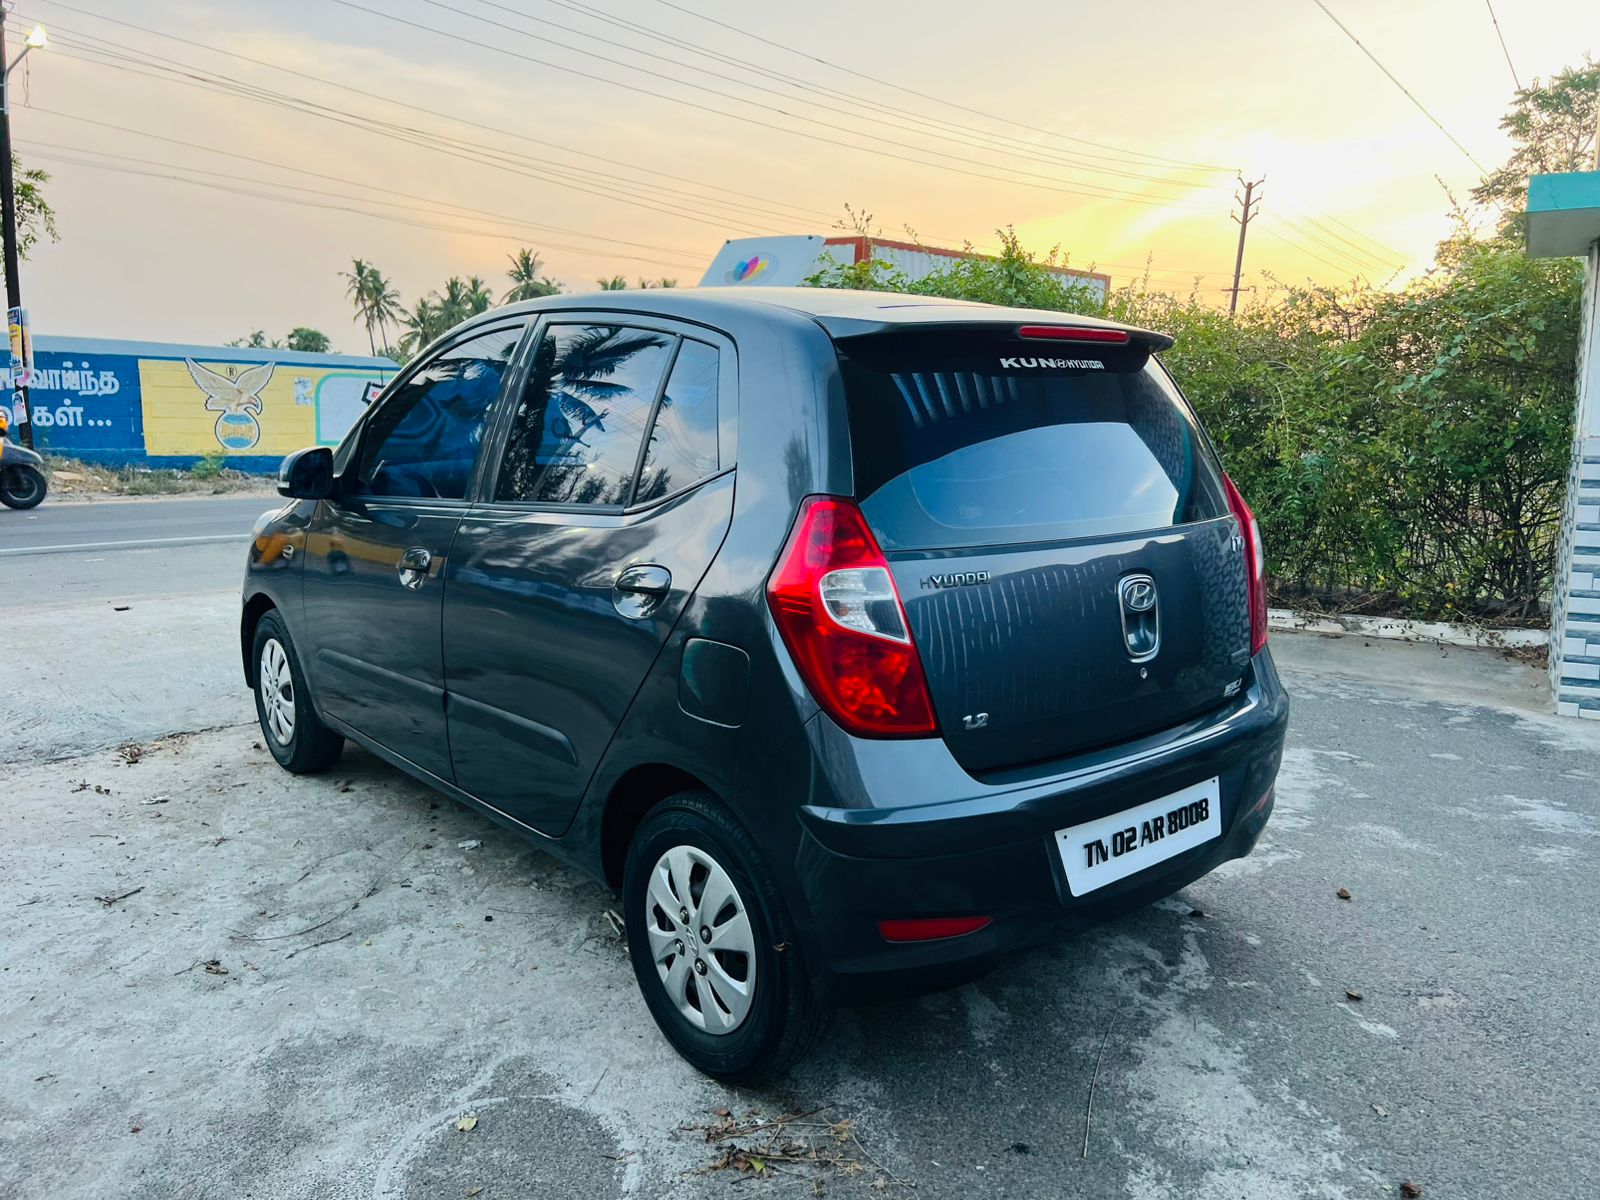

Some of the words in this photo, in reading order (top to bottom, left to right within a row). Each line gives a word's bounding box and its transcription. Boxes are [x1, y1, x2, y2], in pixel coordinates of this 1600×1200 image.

[1000, 357, 1056, 369] KUN
[1066, 359, 1105, 370] HYUNDAI
[920, 571, 991, 590] HYUNDAI
[1083, 838, 1109, 868] TN
[1112, 826, 1137, 858] 02
[1140, 815, 1165, 848] AR
[1167, 797, 1210, 835] 8008
